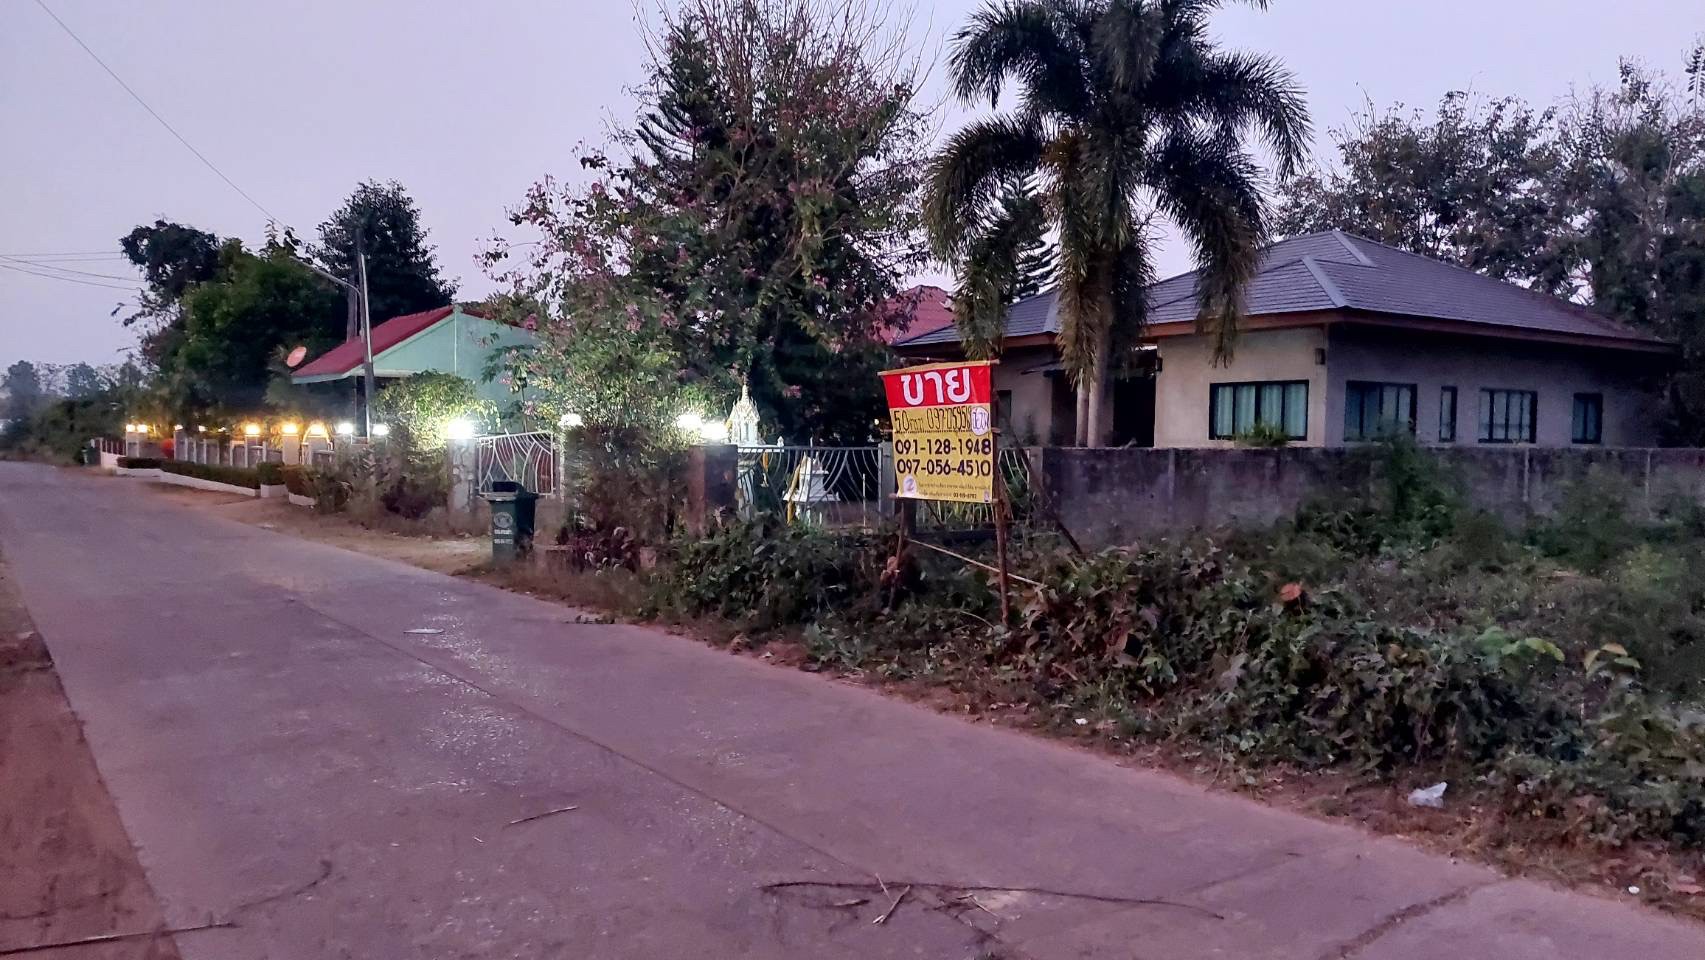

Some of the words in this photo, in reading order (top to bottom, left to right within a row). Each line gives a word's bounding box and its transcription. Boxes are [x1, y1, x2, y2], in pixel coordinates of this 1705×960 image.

[900, 367, 971, 406] ขาย
[894, 436, 992, 456] 091-128-1948
[896, 459, 992, 478] 097-056-4510
